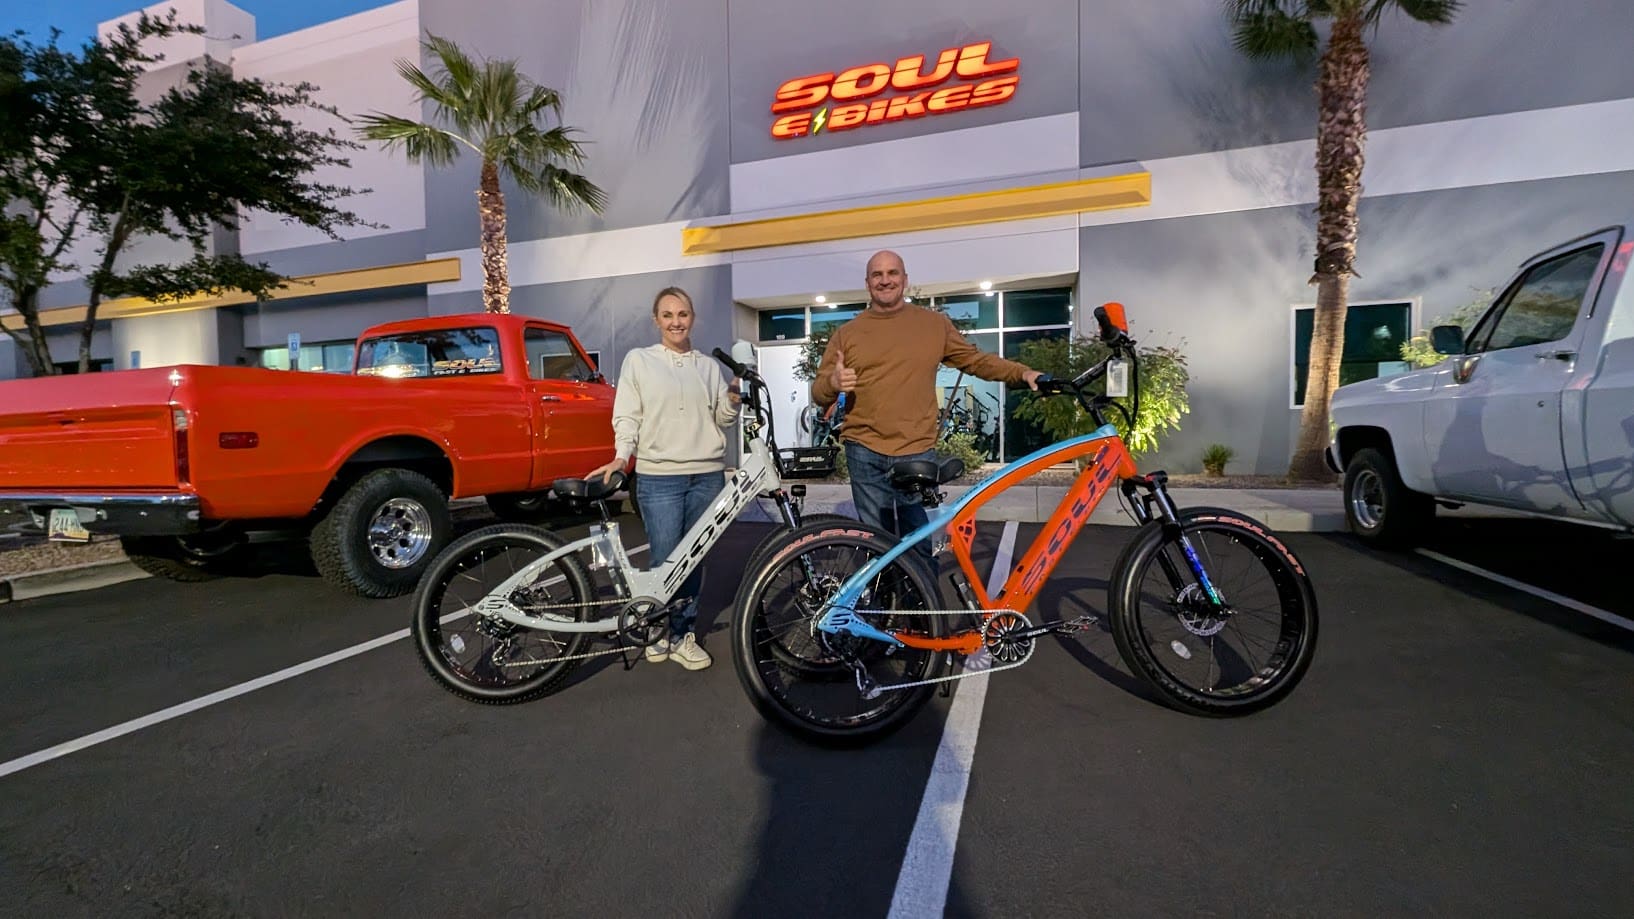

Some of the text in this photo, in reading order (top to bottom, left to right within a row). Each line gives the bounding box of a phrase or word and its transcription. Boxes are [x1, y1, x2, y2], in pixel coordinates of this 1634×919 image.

[771, 41, 1019, 113] SOUL
[827, 76, 1019, 130] BIKES
[664, 466, 766, 594] SOUL
[1021, 453, 1121, 596] SOUL
